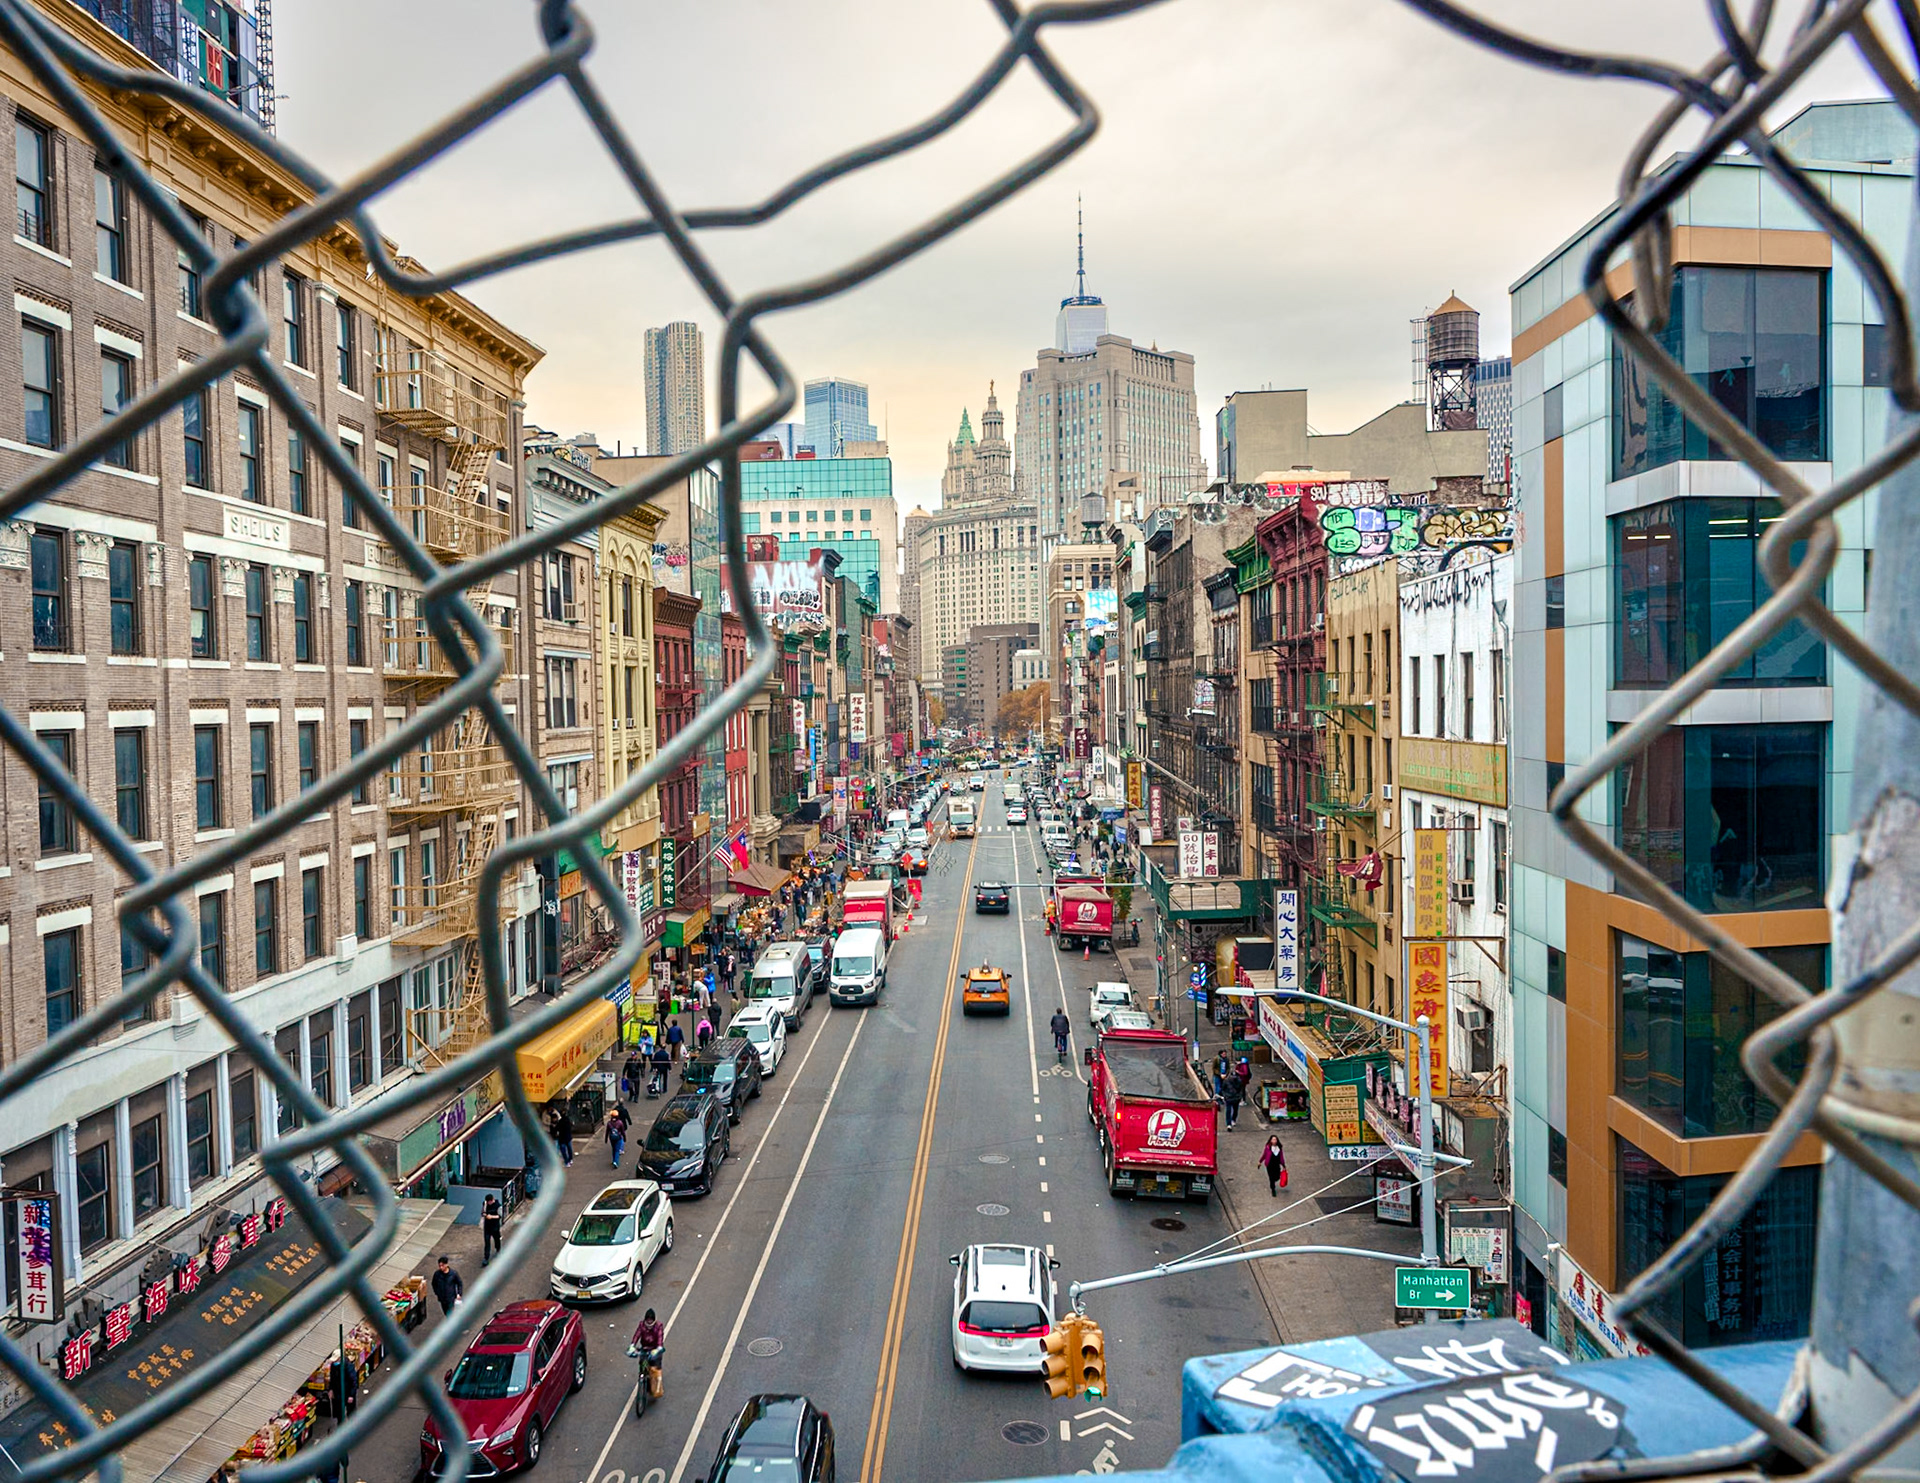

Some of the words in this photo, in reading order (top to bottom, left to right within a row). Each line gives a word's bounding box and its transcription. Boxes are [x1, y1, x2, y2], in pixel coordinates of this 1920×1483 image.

[230, 515, 281, 543] SHEILS
[1278, 892, 1297, 982] 開心大藥房
[1403, 1275, 1463, 1286] Manhattan
[1409, 1289, 1421, 1299] Br
